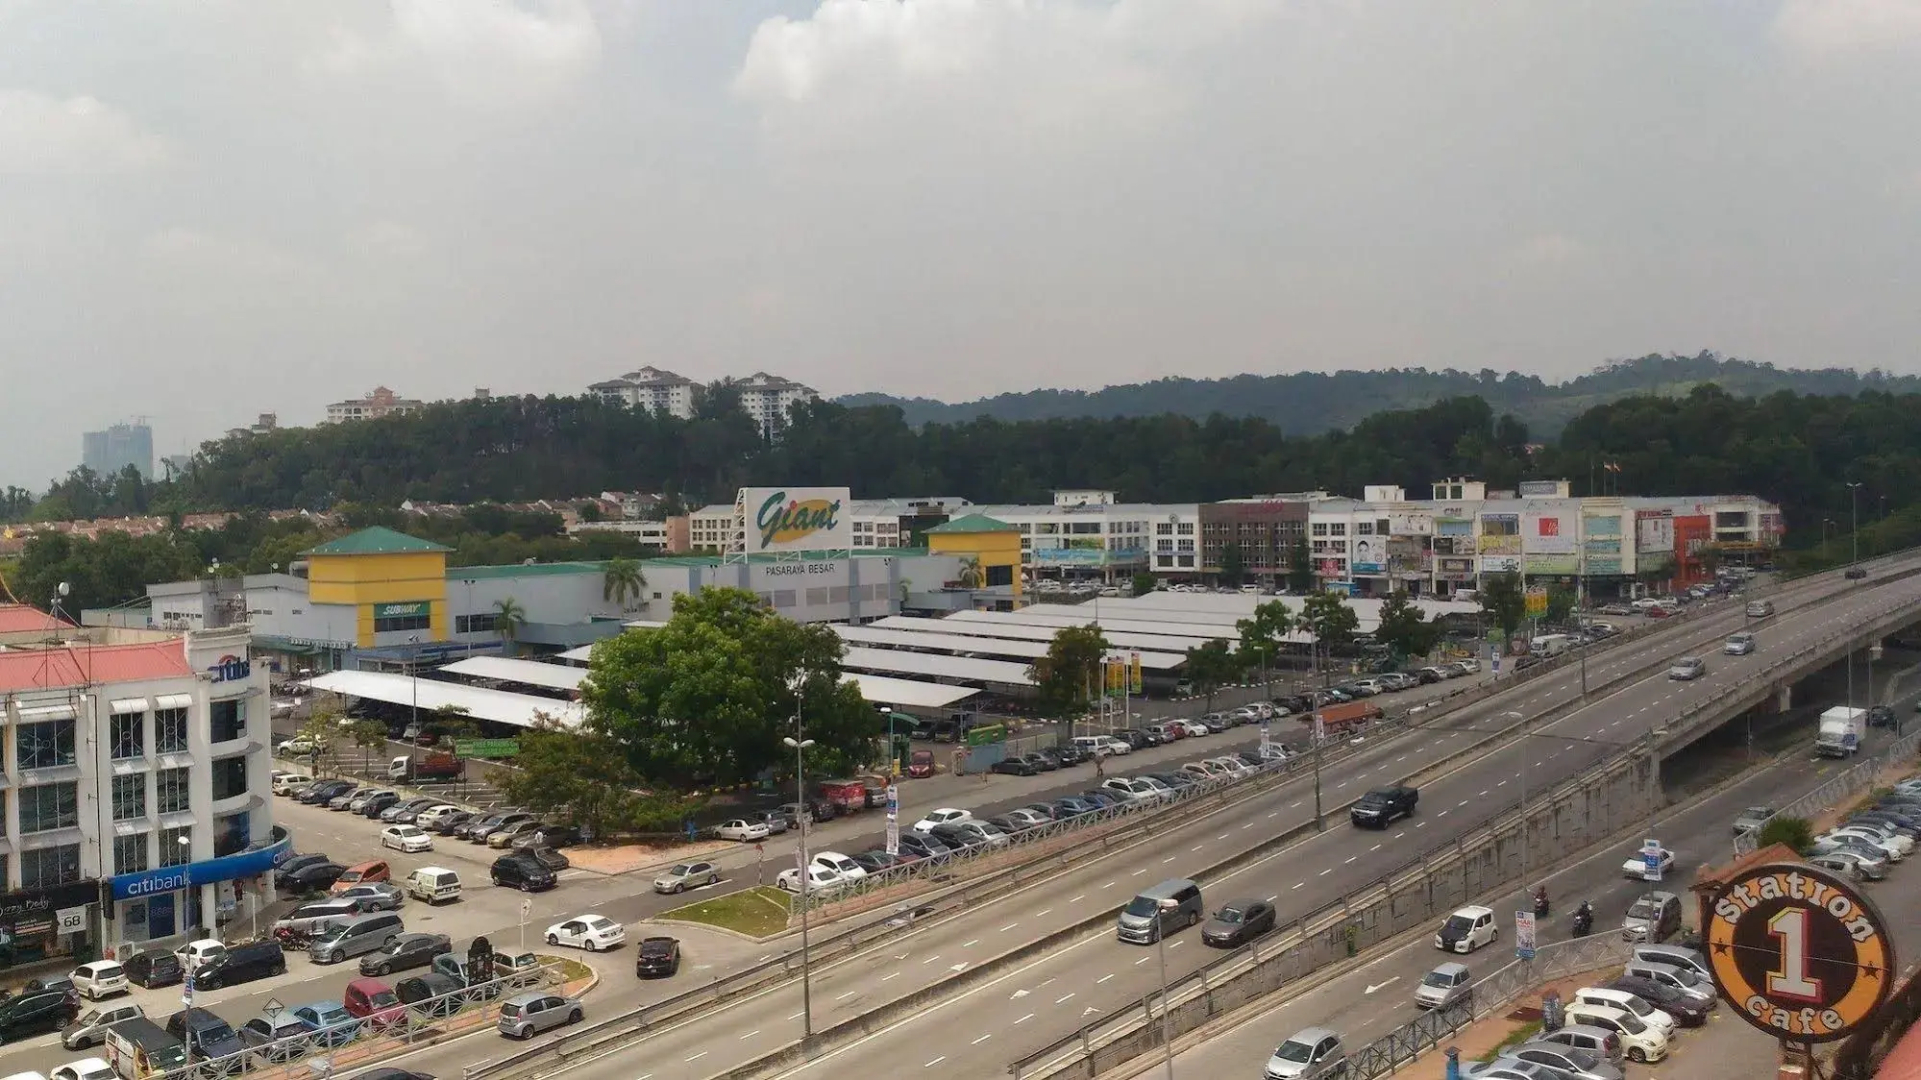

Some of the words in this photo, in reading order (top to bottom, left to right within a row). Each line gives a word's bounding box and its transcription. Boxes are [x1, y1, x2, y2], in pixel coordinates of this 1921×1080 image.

[757, 491, 841, 549] Giant
[766, 564, 805, 576] PASARAYA
[808, 563, 835, 574] BESAR
[383, 603, 421, 615] SUBWAY
[128, 870, 191, 895] citibank
[64, 915, 81, 927] 68
[1766, 906, 1822, 1003] 1
